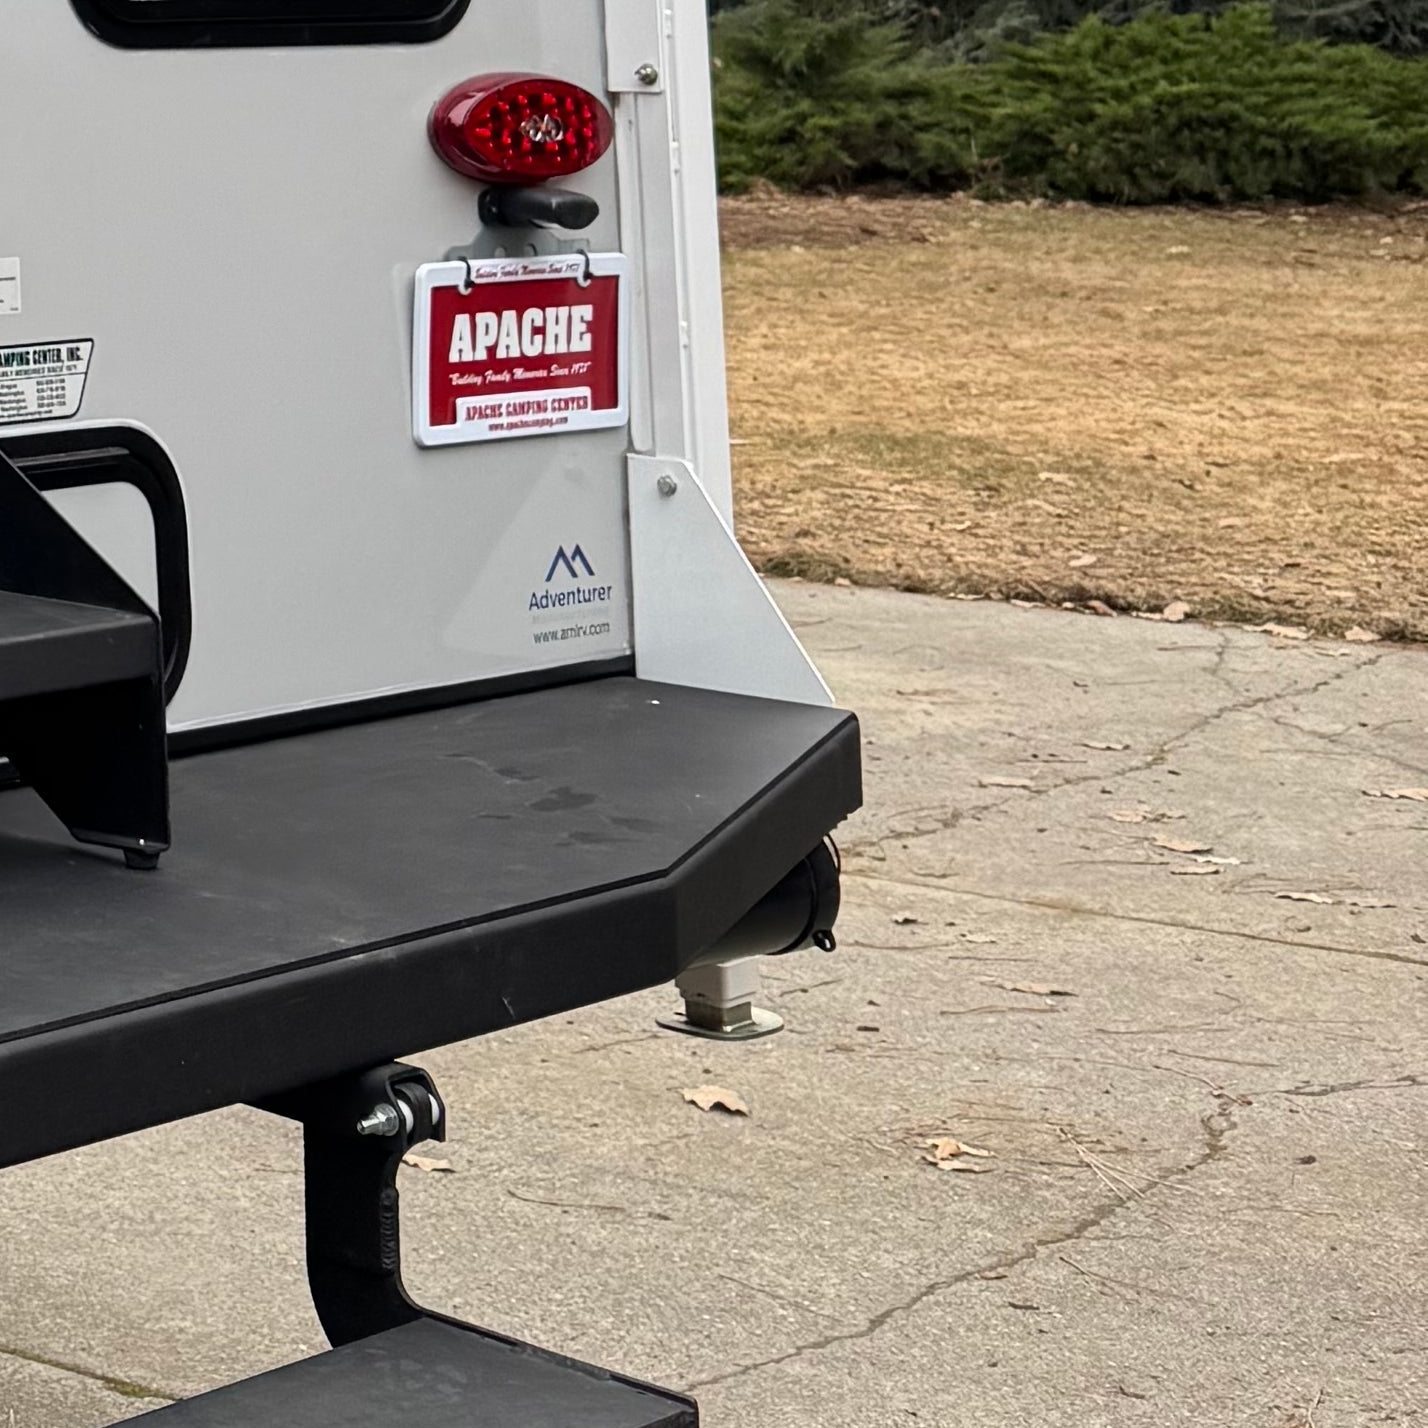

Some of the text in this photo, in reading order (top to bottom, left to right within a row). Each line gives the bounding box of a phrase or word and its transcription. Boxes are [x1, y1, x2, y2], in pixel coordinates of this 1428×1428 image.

[448, 304, 593, 363] APACHE
[464, 396, 588, 421] APACHE CAMPING CENTER
[528, 585, 612, 611] Adventurer
